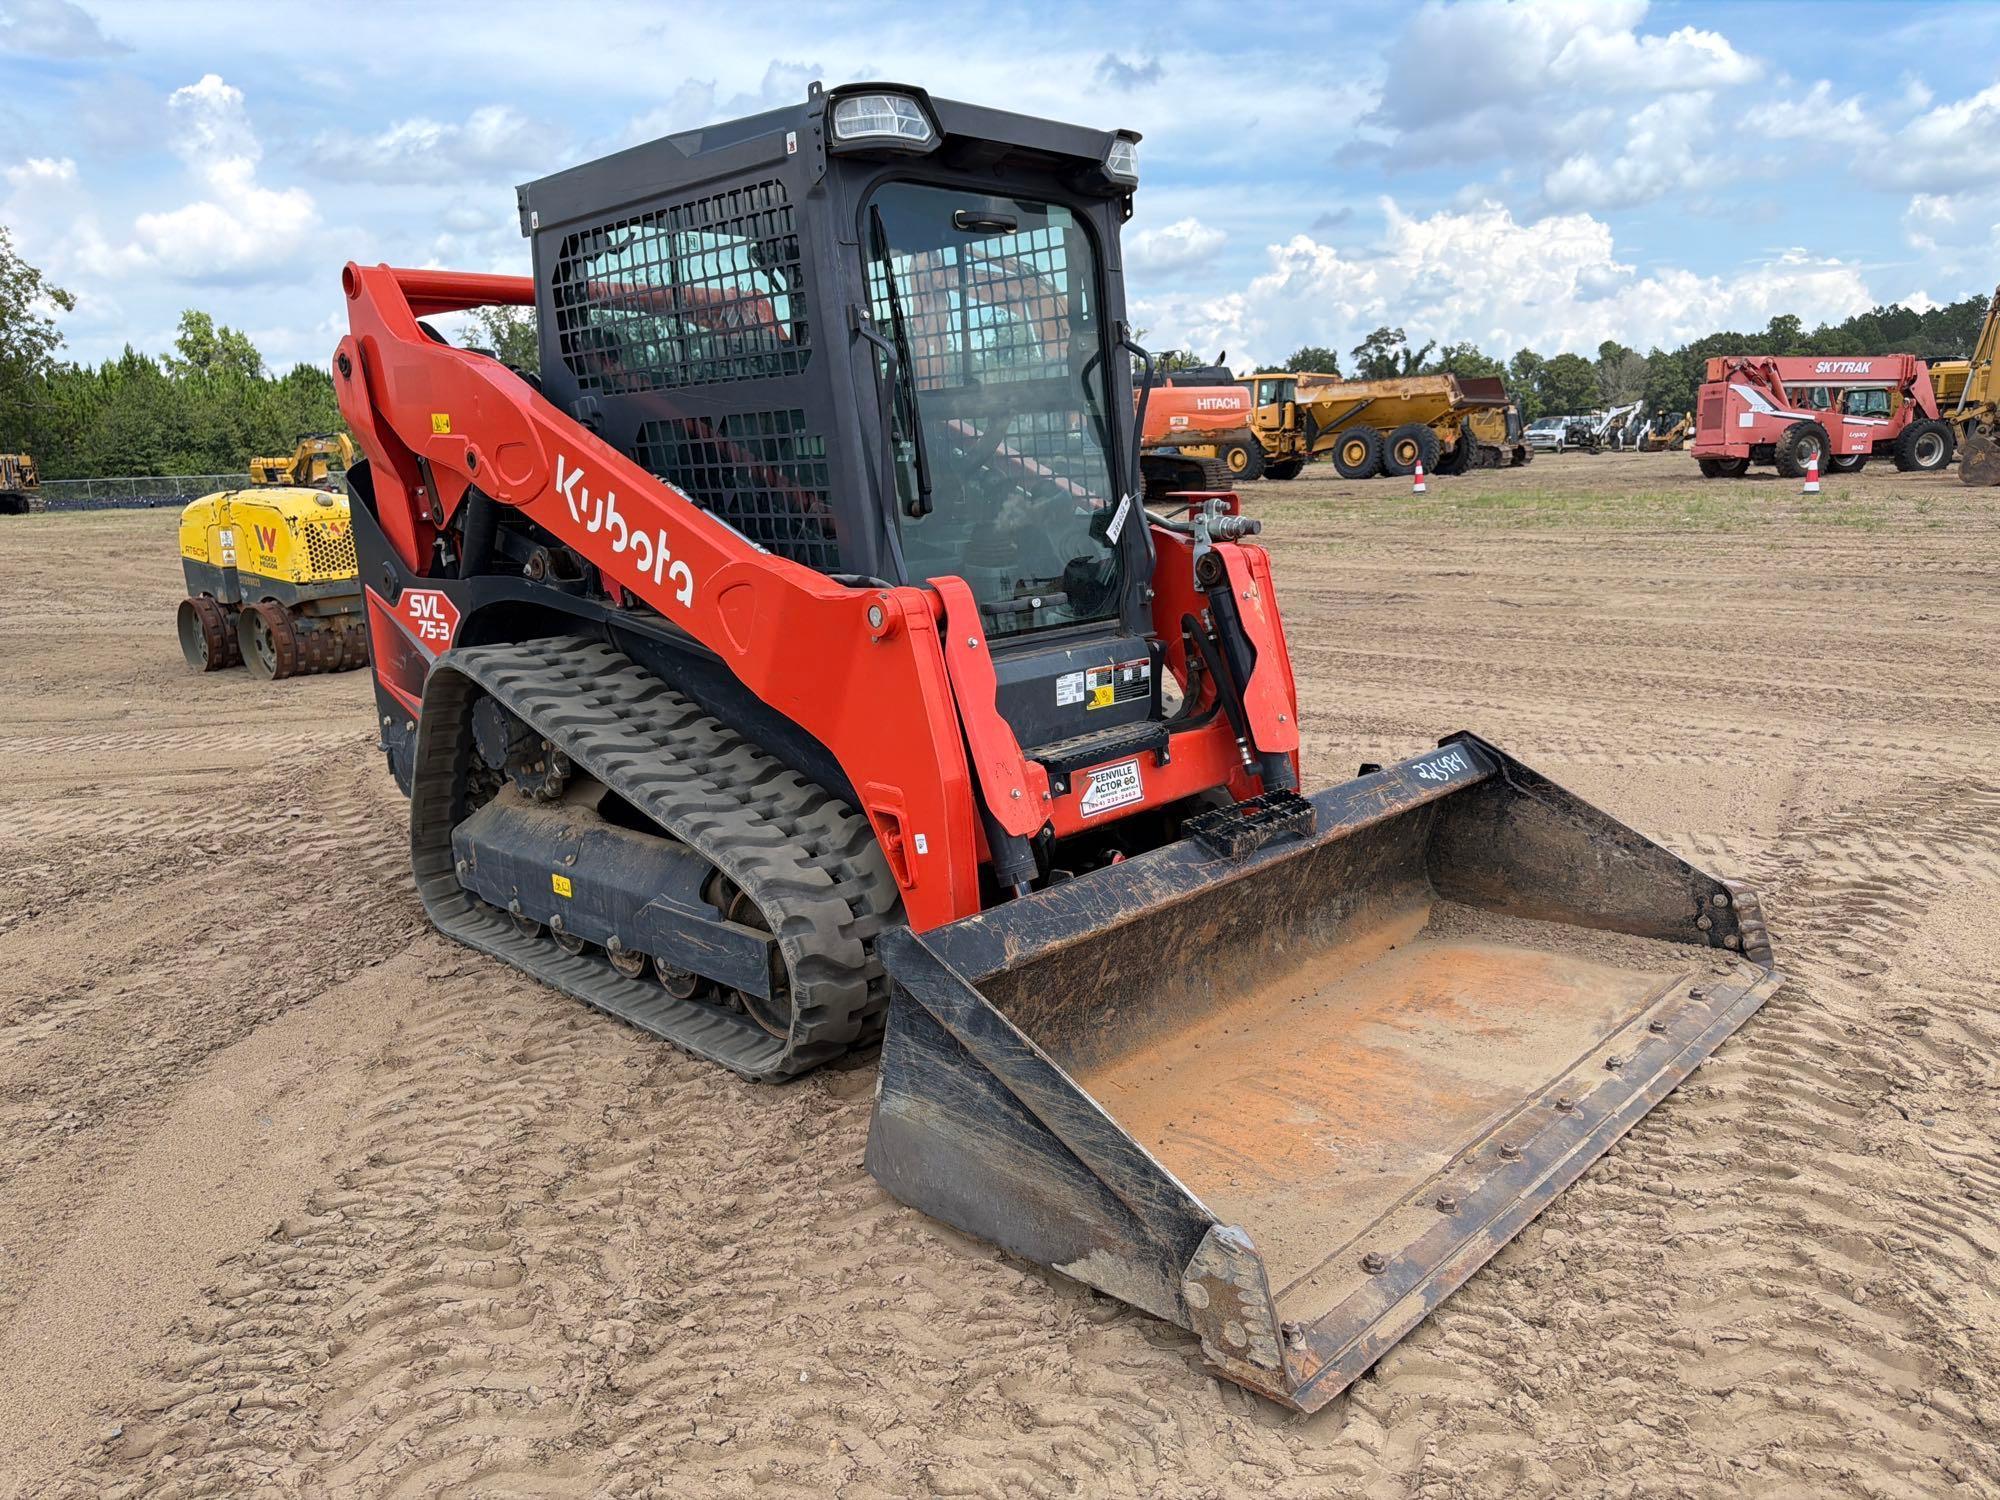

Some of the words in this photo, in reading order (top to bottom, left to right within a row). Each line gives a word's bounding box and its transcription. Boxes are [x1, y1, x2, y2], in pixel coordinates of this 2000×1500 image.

[1815, 361, 1872, 374] SKYTRAK
[1197, 397, 1240, 410] HITACHI
[555, 453, 694, 608] Kubota
[409, 594, 445, 620] SVL
[418, 620, 450, 640] 75-3
